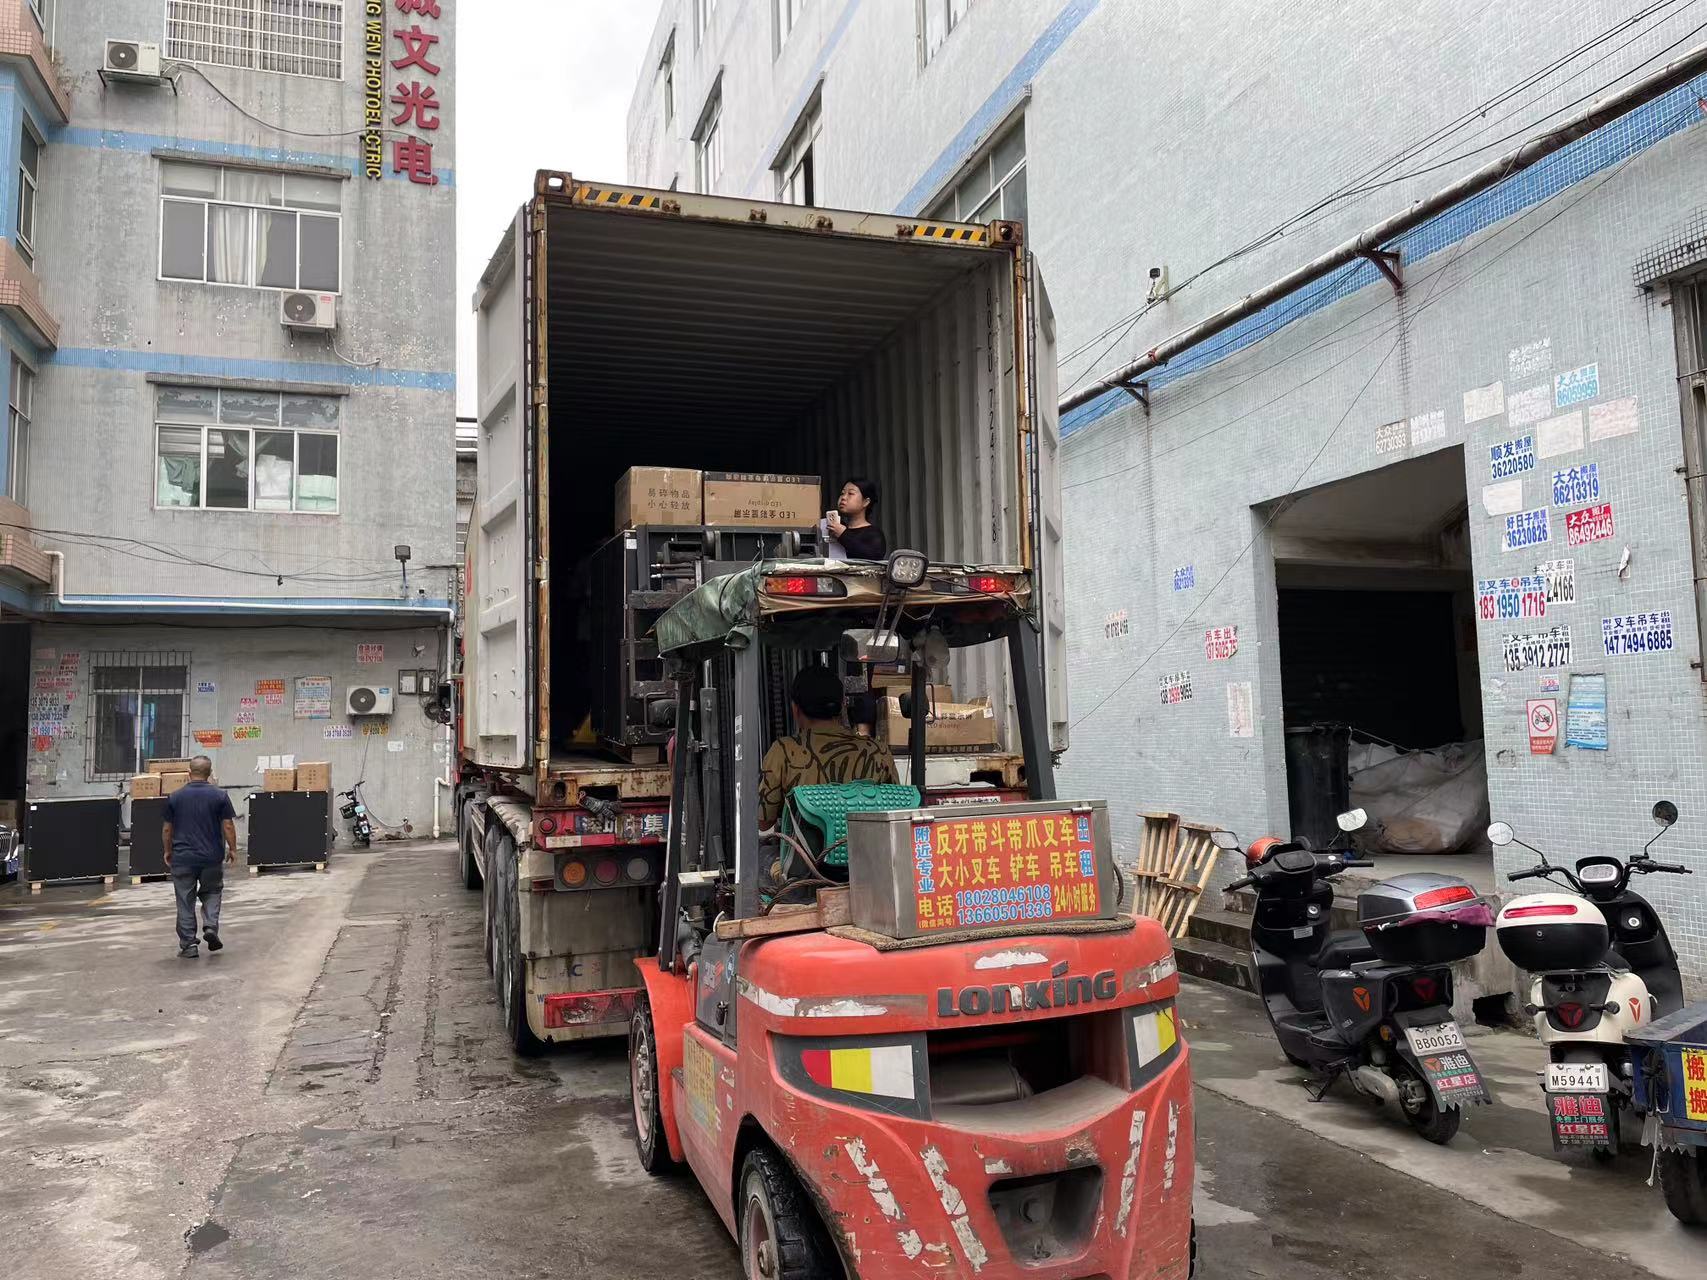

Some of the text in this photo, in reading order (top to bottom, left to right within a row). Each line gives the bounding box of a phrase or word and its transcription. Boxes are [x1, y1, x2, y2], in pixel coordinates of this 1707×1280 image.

[366, 20, 381, 56] WEN
[1492, 453, 1534, 479] 36220580
[648, 488, 690, 499] 易碎物品
[1553, 478, 1599, 506] 86213319
[648, 500, 690, 511] 小心轻放
[779, 510, 796, 519] LED
[1507, 523, 1548, 548] 36230826
[1569, 517, 1613, 545] 86492446
[1479, 591, 1545, 619] 183 1950 1716
[1614, 613, 1660, 629] 叉车吊车
[1604, 629, 1672, 655] 147 7494 6885
[1504, 642, 1570, 671] 135 3912 2727
[936, 816, 1076, 856] 反牙带斗带爪叉车
[1076, 816, 1095, 878] 出租
[914, 825, 935, 894] 附近专业
[937, 850, 1077, 889] 大小叉车 铲车 吊车
[918, 894, 954, 919] 电话
[955, 884, 1052, 908] 18028046108
[1054, 884, 1097, 914] 24小时服务
[957, 901, 1053, 926] 13660501336
[1415, 1034, 1461, 1050] BB0052
[1439, 1054, 1472, 1071] 雅迪
[1437, 1074, 1477, 1088] 红星店
[1552, 1075, 1601, 1086] M59441
[1554, 1095, 1605, 1117] 雅迪
[1559, 1124, 1605, 1135] 红星店
